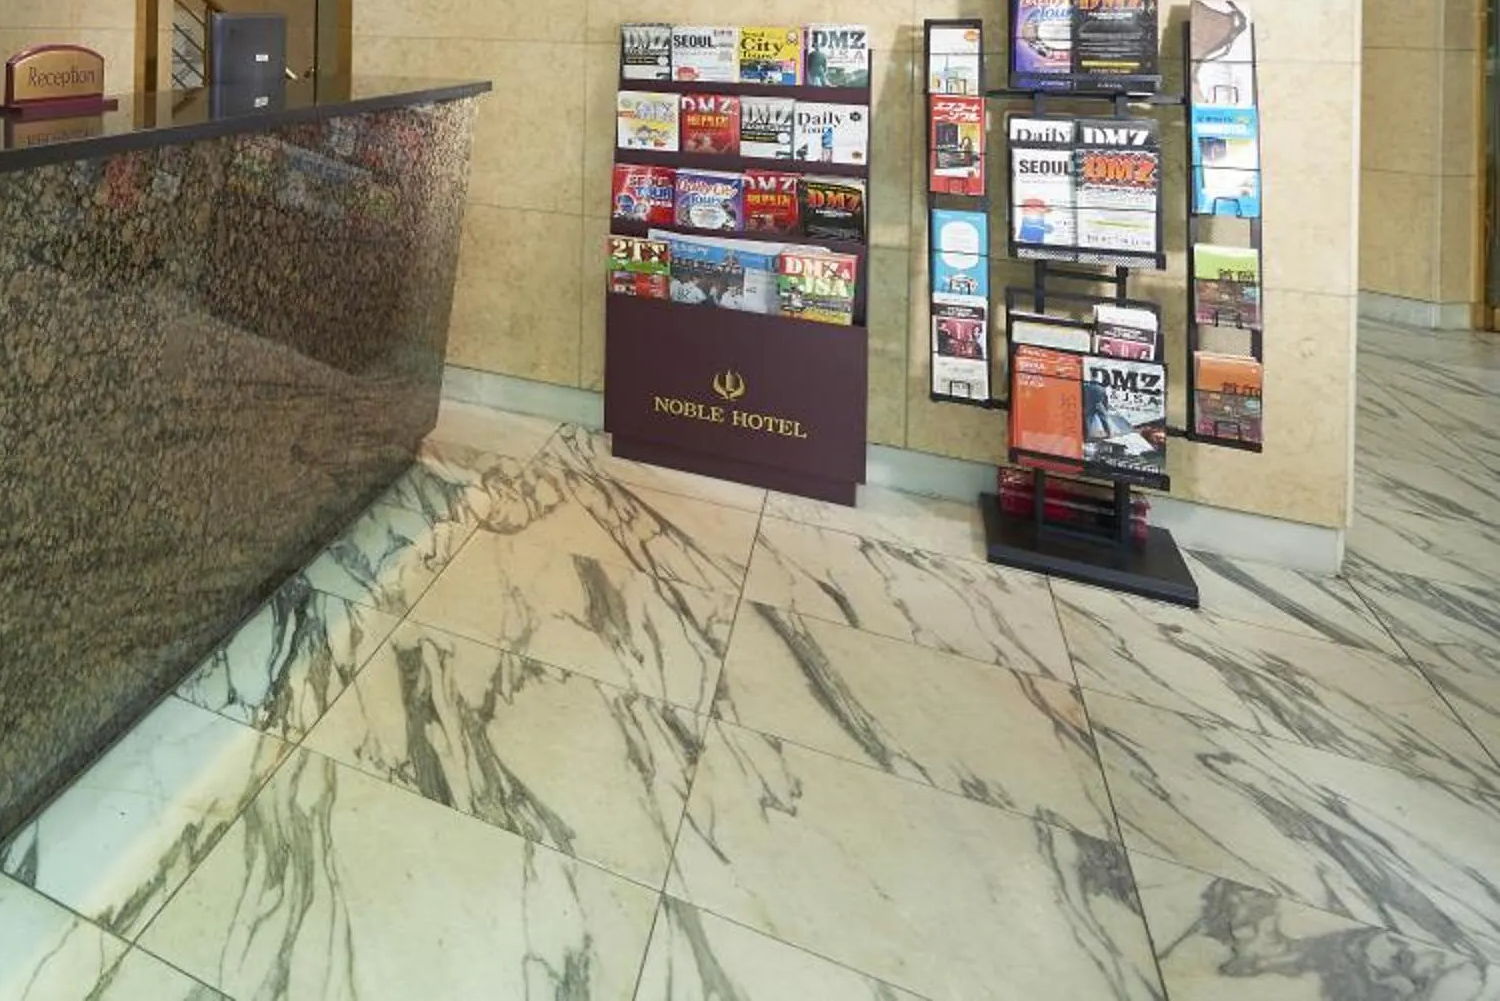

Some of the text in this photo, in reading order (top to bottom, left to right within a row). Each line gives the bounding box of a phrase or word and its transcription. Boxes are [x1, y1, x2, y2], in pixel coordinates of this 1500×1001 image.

[673, 34, 714, 49] SEOUL
[741, 36, 784, 57] City
[811, 30, 866, 50] DMZ
[28, 66, 95, 89] Reception
[681, 95, 733, 114] DMZ
[798, 110, 842, 127] Daily
[1018, 127, 1071, 142] Daily
[1082, 127, 1149, 145] DMZ
[1019, 159, 1070, 175] SEOUL
[1084, 156, 1156, 183] DMZ
[742, 176, 794, 192] DMZ
[807, 189, 862, 210] DMZ
[785, 256, 838, 280] DMZ
[1090, 367, 1161, 396] DMZ
[654, 397, 808, 439] NOBLE HOTEL
